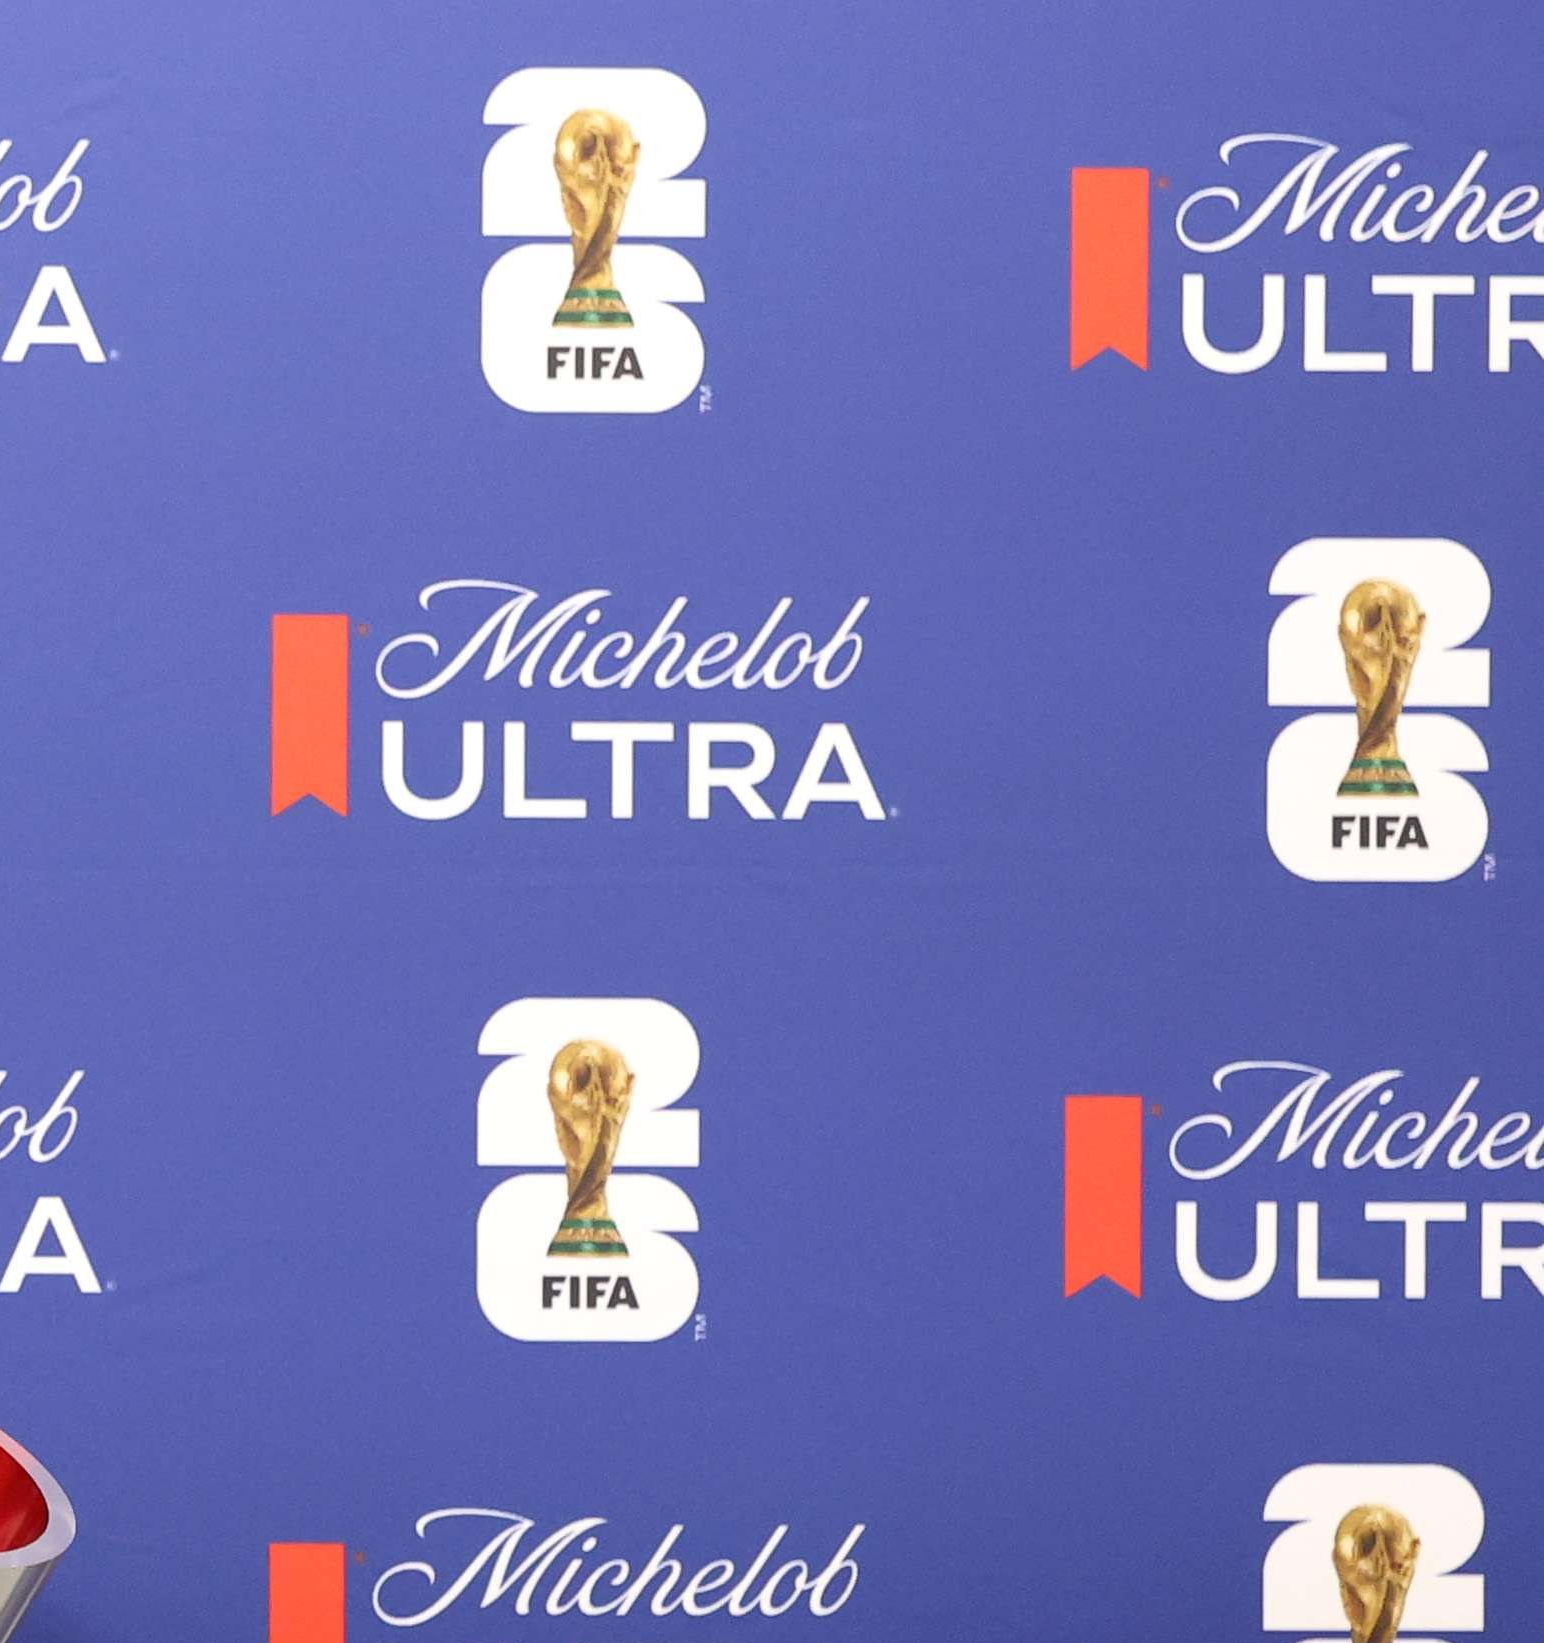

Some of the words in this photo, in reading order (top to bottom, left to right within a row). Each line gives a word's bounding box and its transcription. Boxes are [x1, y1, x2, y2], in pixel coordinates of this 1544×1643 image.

[546, 346, 644, 380] FIFA
[1182, 273, 1544, 375] ULTR
[375, 578, 870, 699] Michelob
[381, 720, 886, 821] ULTRA
[1331, 815, 1429, 849] FIFA
[541, 1275, 640, 1310] FIFA
[1175, 1200, 1544, 1301] ULTR
[372, 1507, 866, 1627] Michelob
